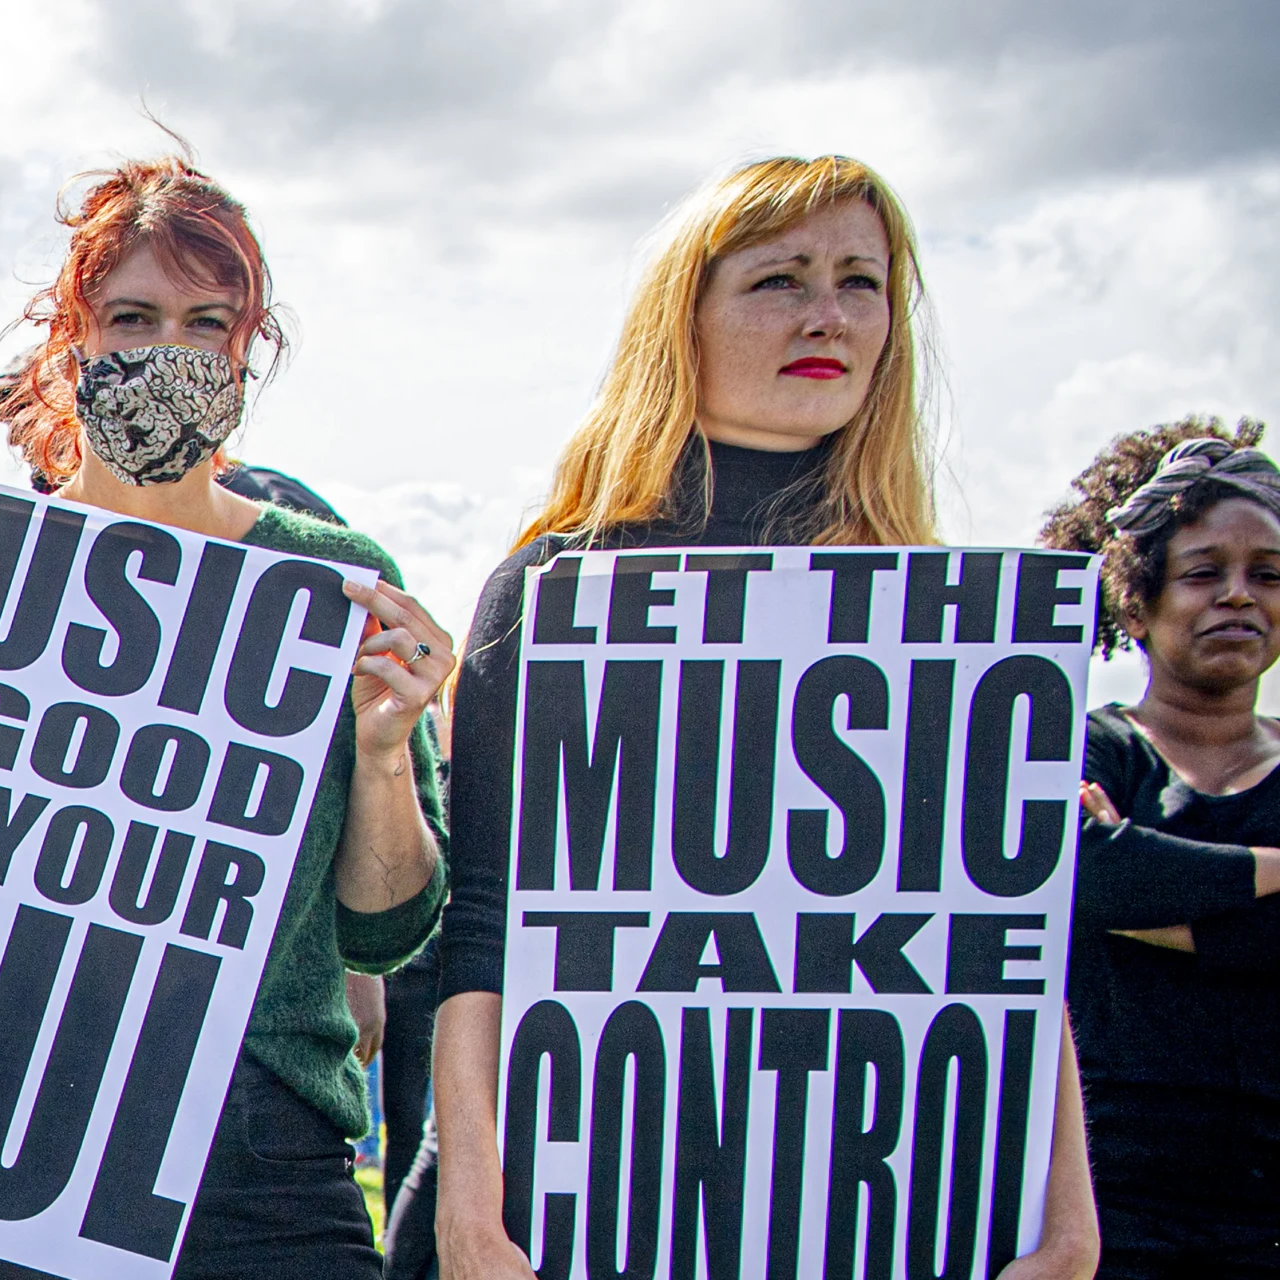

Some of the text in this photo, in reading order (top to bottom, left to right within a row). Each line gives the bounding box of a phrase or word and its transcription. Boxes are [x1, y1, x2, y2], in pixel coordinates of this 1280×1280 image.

[532, 552, 1092, 645] LET THE
[515, 654, 1074, 898] MUSIC
[521, 911, 1047, 995] TAKE
